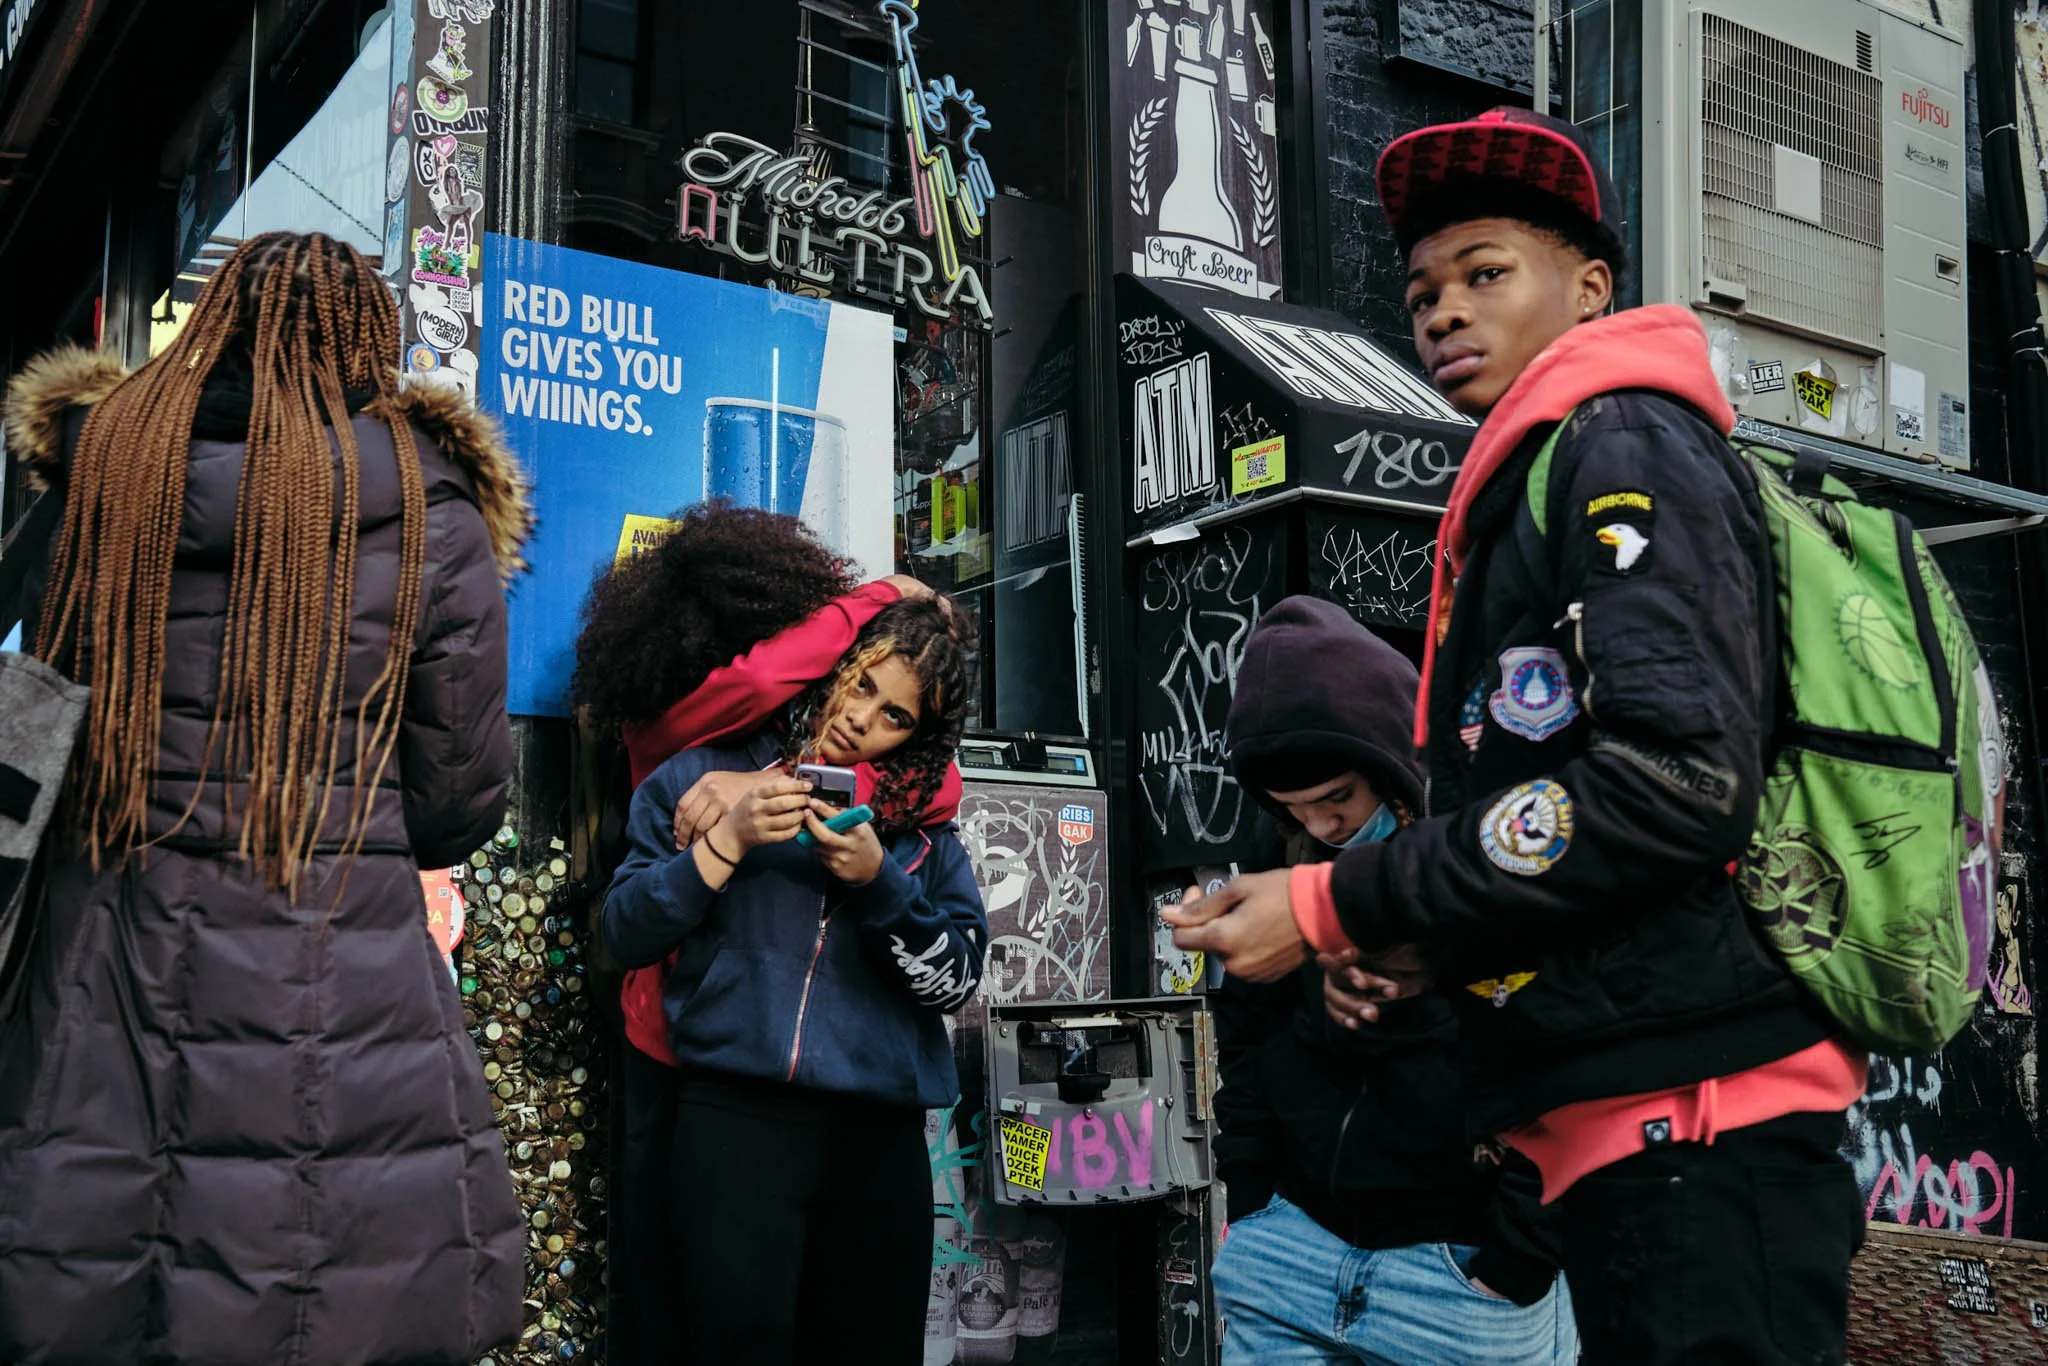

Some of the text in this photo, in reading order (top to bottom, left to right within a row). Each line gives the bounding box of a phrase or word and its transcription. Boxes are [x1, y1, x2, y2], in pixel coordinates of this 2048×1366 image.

[1902, 91, 1950, 128] FUJITSU
[682, 132, 914, 236] Michelob
[722, 192, 995, 330] ULTRA
[1148, 237, 1253, 285] Craft Beer
[422, 310, 464, 337] MODERN
[504, 279, 660, 347] RED BULL
[435, 326, 460, 346] GIRLS
[501, 327, 683, 395] GIVES YOU
[1203, 307, 1479, 427] ATM
[1798, 373, 1832, 401] KEST
[1798, 388, 1825, 413] GAK
[500, 373, 653, 437] WIIINGS.
[1134, 352, 1216, 513] ATM
[1587, 492, 1653, 516] AIRBORNE
[632, 529, 667, 546] AVAI
[1643, 751, 1727, 801] ARINES
[1062, 807, 1091, 822] RIBS
[1063, 824, 1088, 840] GAK
[1001, 1118, 1049, 1142] SPACER
[1006, 1170, 1041, 1189] PTEK
